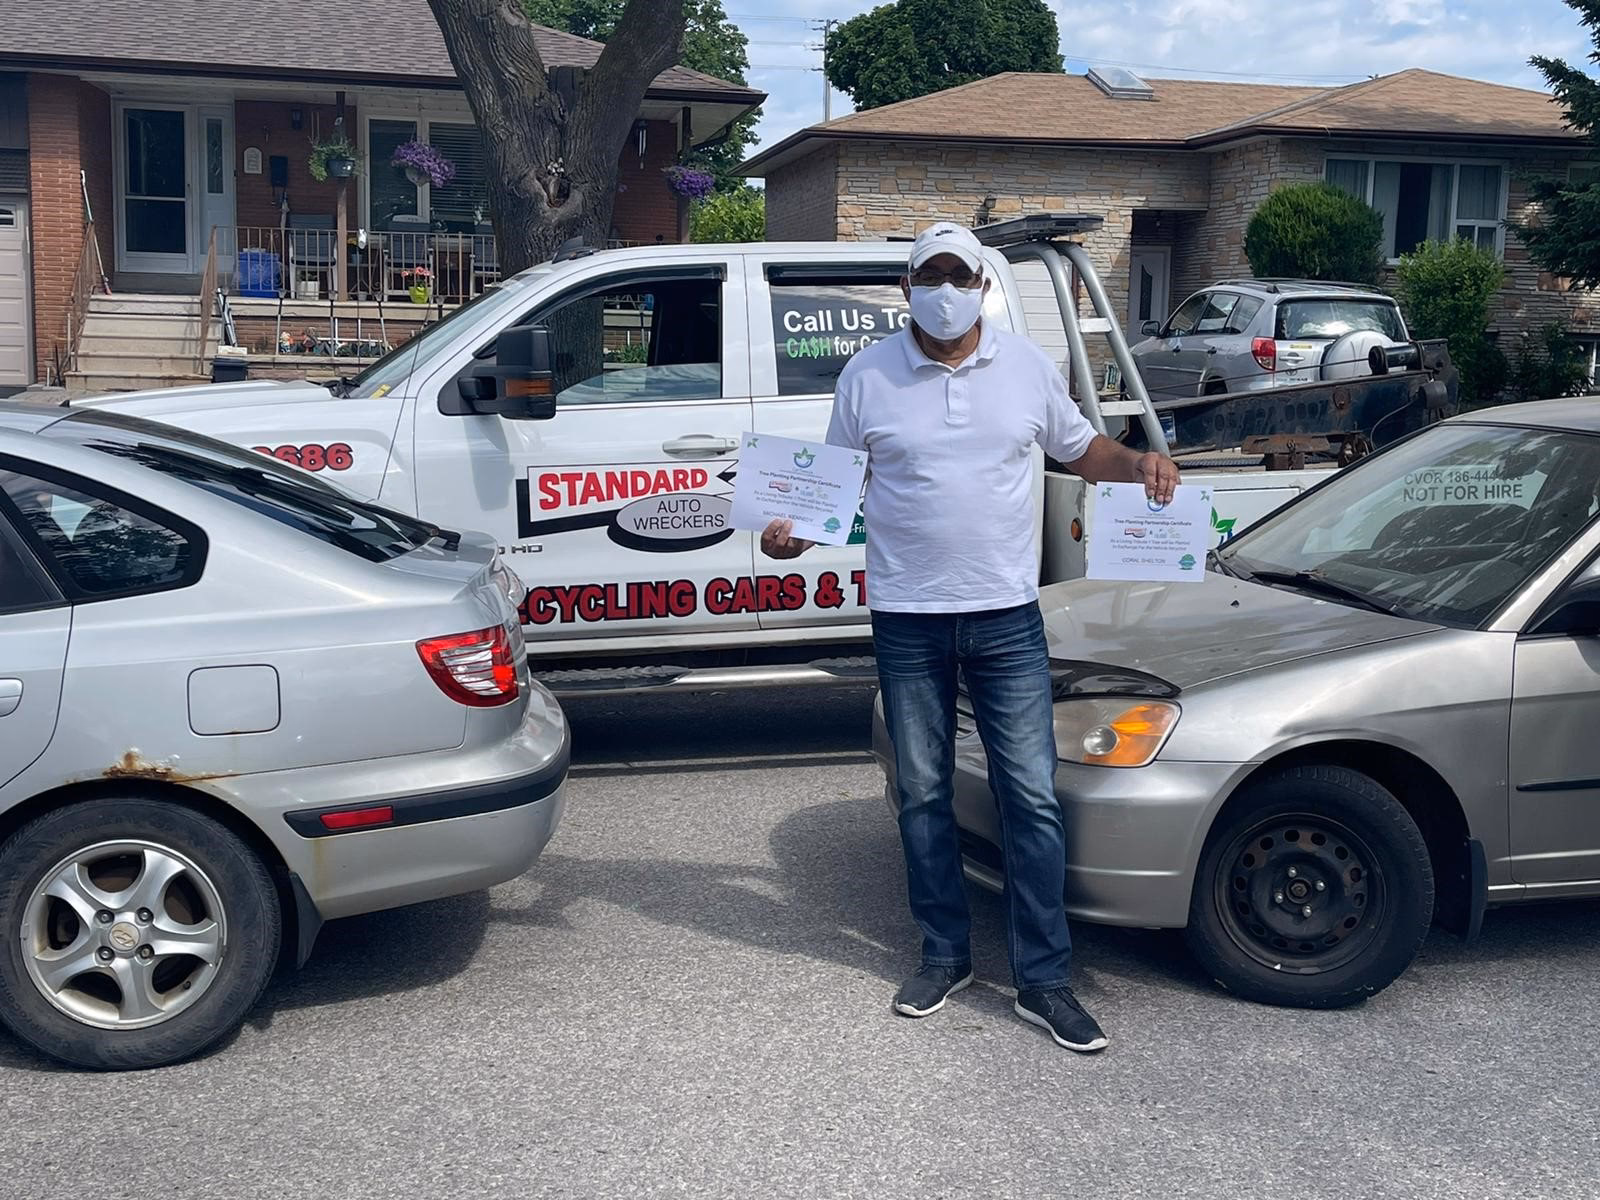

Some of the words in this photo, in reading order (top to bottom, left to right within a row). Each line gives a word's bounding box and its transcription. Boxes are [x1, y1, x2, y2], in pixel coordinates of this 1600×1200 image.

[783, 309, 833, 333] Call
[841, 308, 875, 330] Us
[786, 336, 832, 359] CA$H
[834, 335, 857, 356] for
[252, 442, 354, 472] 686
[1404, 471, 1443, 485] CVOR
[538, 468, 708, 511] STANDARD
[1403, 487, 1438, 502] NOT
[1444, 485, 1479, 501] FOR
[1484, 484, 1523, 500] HIRE
[657, 499, 701, 513] AUTO
[633, 514, 725, 531] WRECKERS
[512, 545, 543, 554] HD
[704, 573, 807, 615] CARS
[814, 571, 845, 609] &
